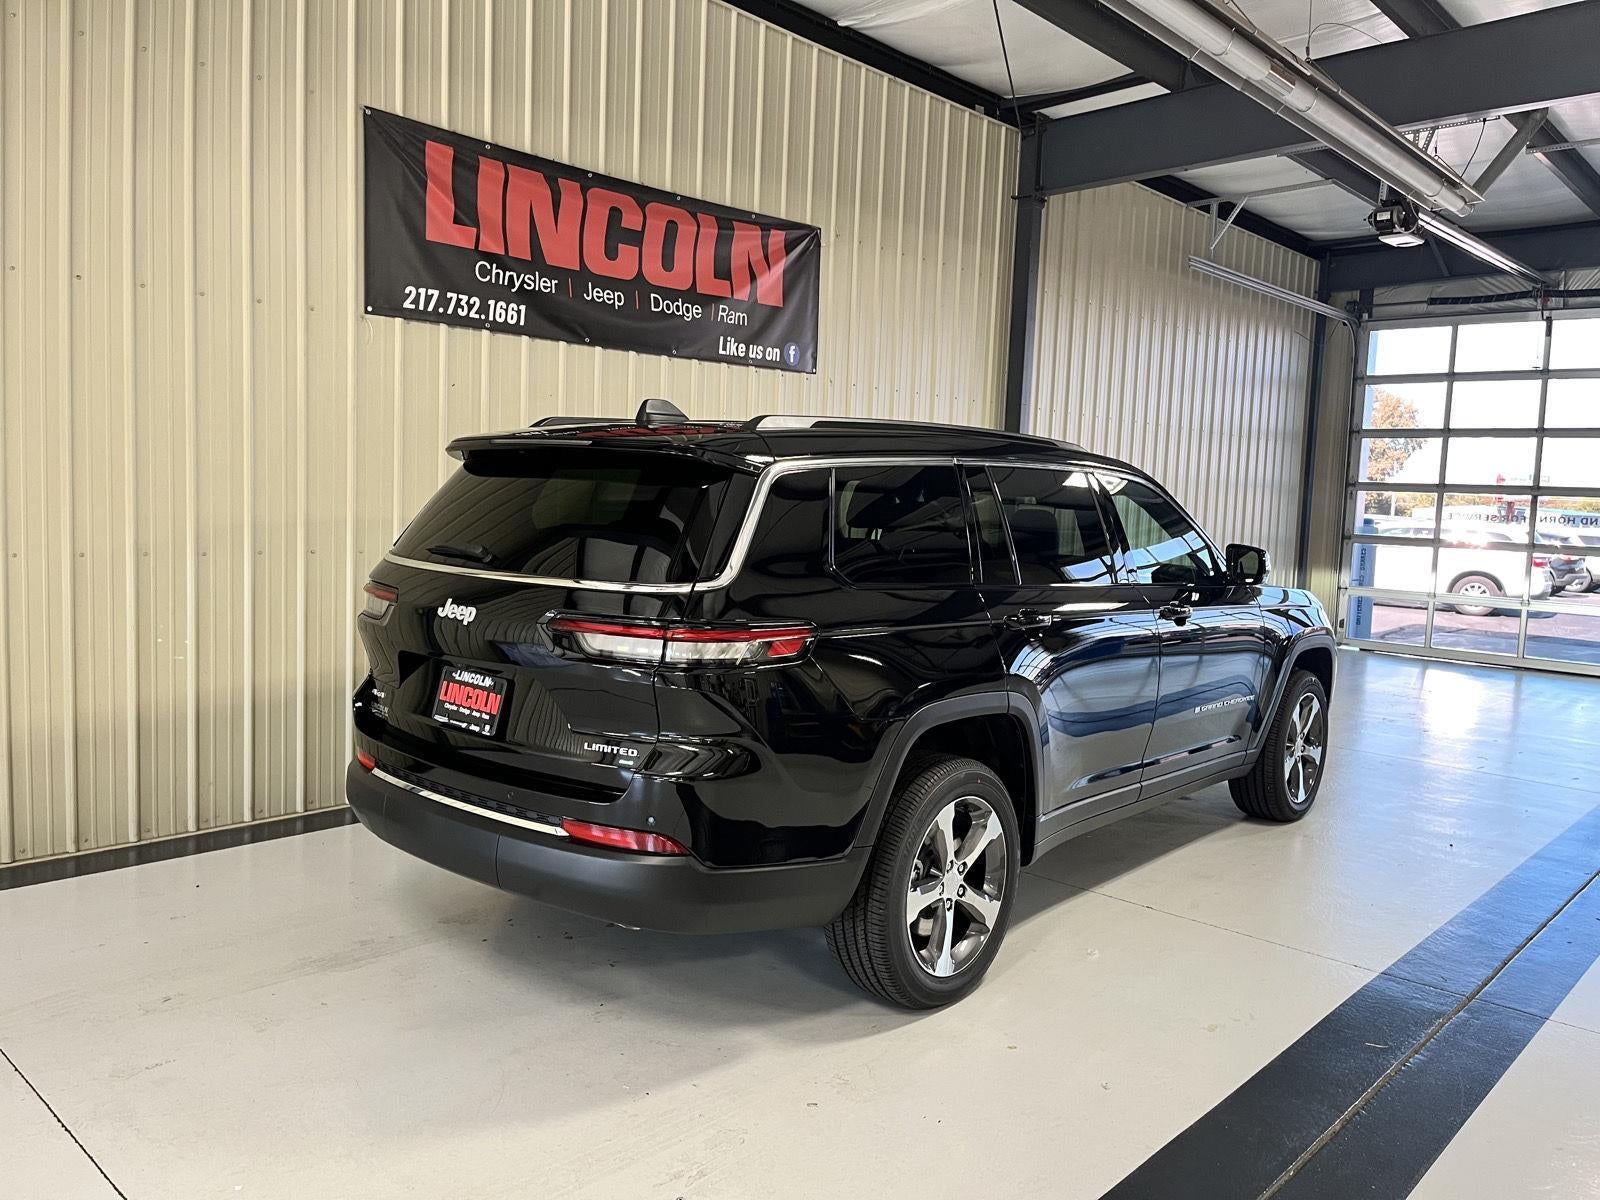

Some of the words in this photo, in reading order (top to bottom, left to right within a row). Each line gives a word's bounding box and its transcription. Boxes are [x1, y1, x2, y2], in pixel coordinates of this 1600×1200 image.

[425, 139, 787, 307] LINCOLN
[402, 285, 527, 326] 217.732.1661
[475, 260, 558, 295] Chrysler
[583, 282, 625, 307] Jeep
[650, 293, 702, 321] Dodge
[717, 304, 748, 326] Ram
[718, 336, 746, 359] Like
[748, 344, 763, 361] us
[765, 345, 780, 362] on
[437, 598, 477, 625] Jeep
[455, 670, 493, 687] LINCOLN
[440, 681, 502, 715] LINCOLN
[583, 741, 639, 757] LIMITED
